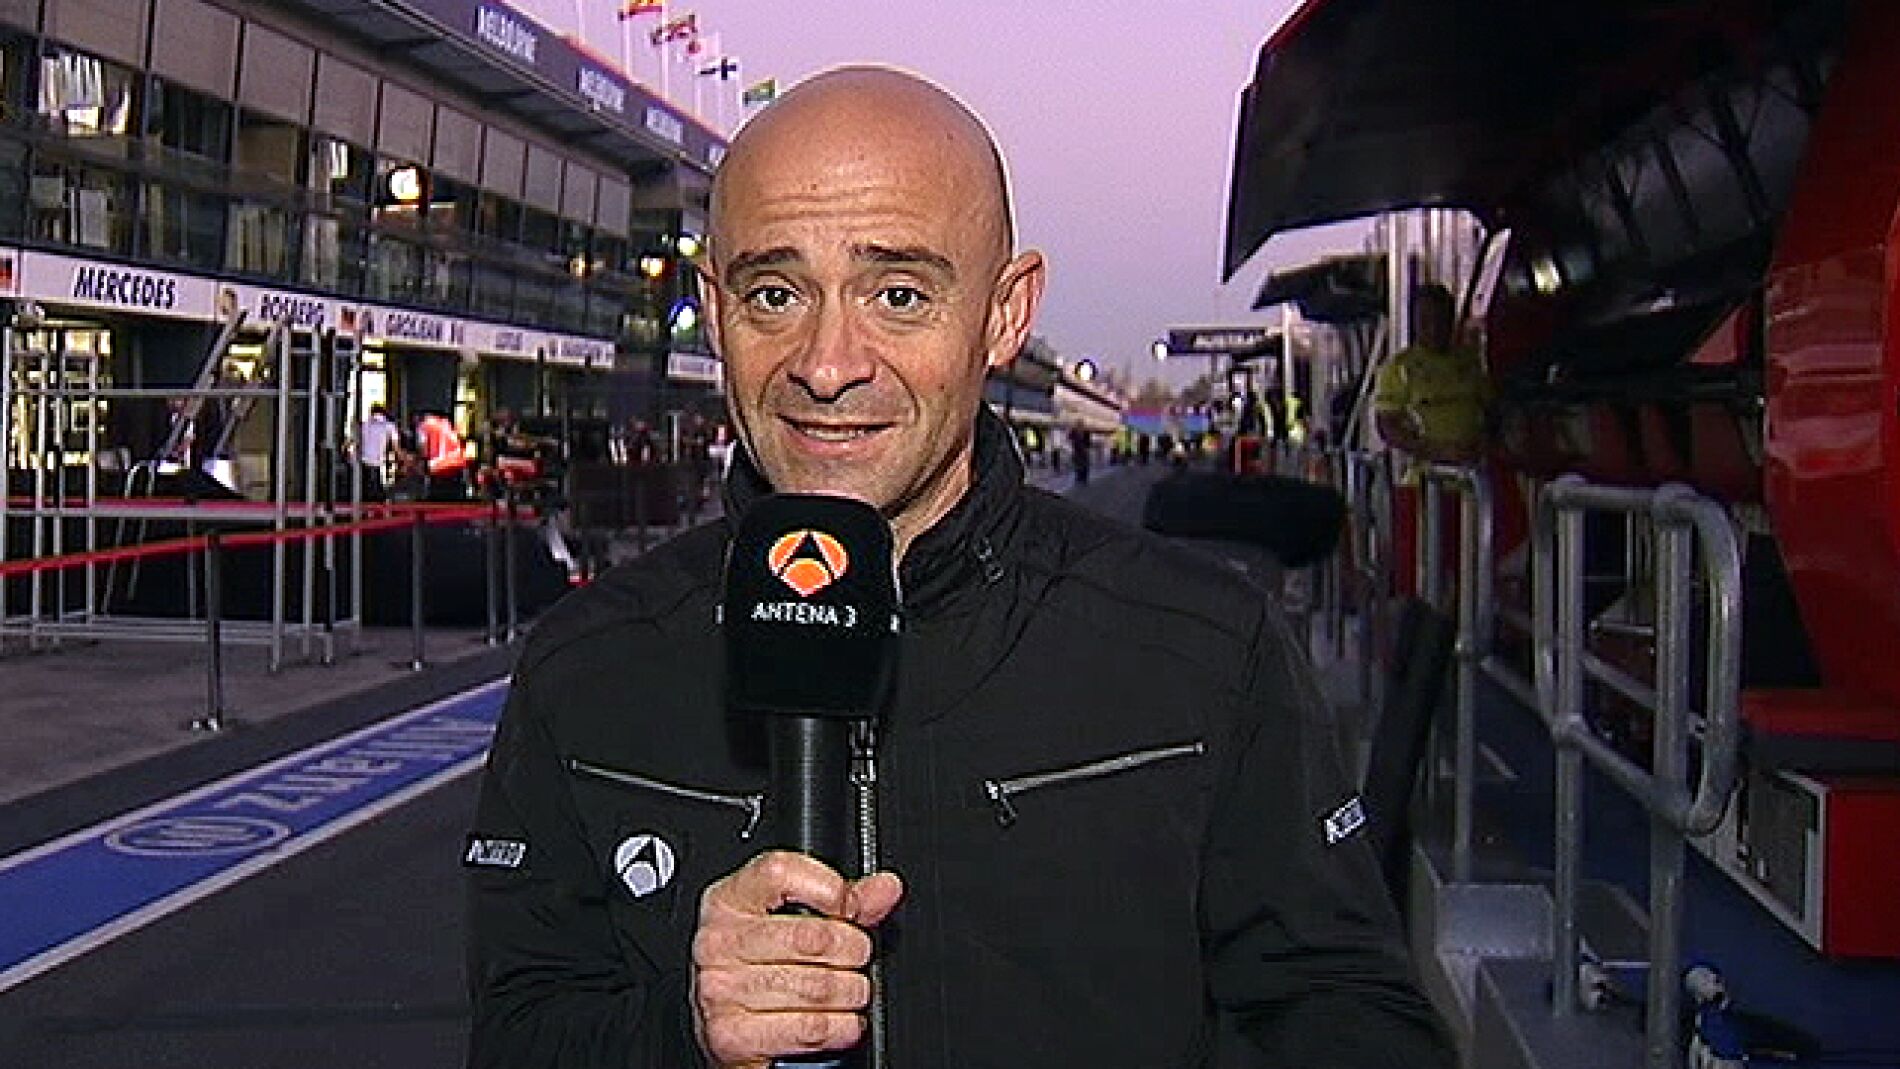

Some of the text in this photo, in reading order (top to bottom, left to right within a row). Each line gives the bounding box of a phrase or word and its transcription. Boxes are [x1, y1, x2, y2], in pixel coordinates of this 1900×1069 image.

[74, 265, 176, 310] MERCEDES
[751, 602, 858, 628] ANTENA 3
